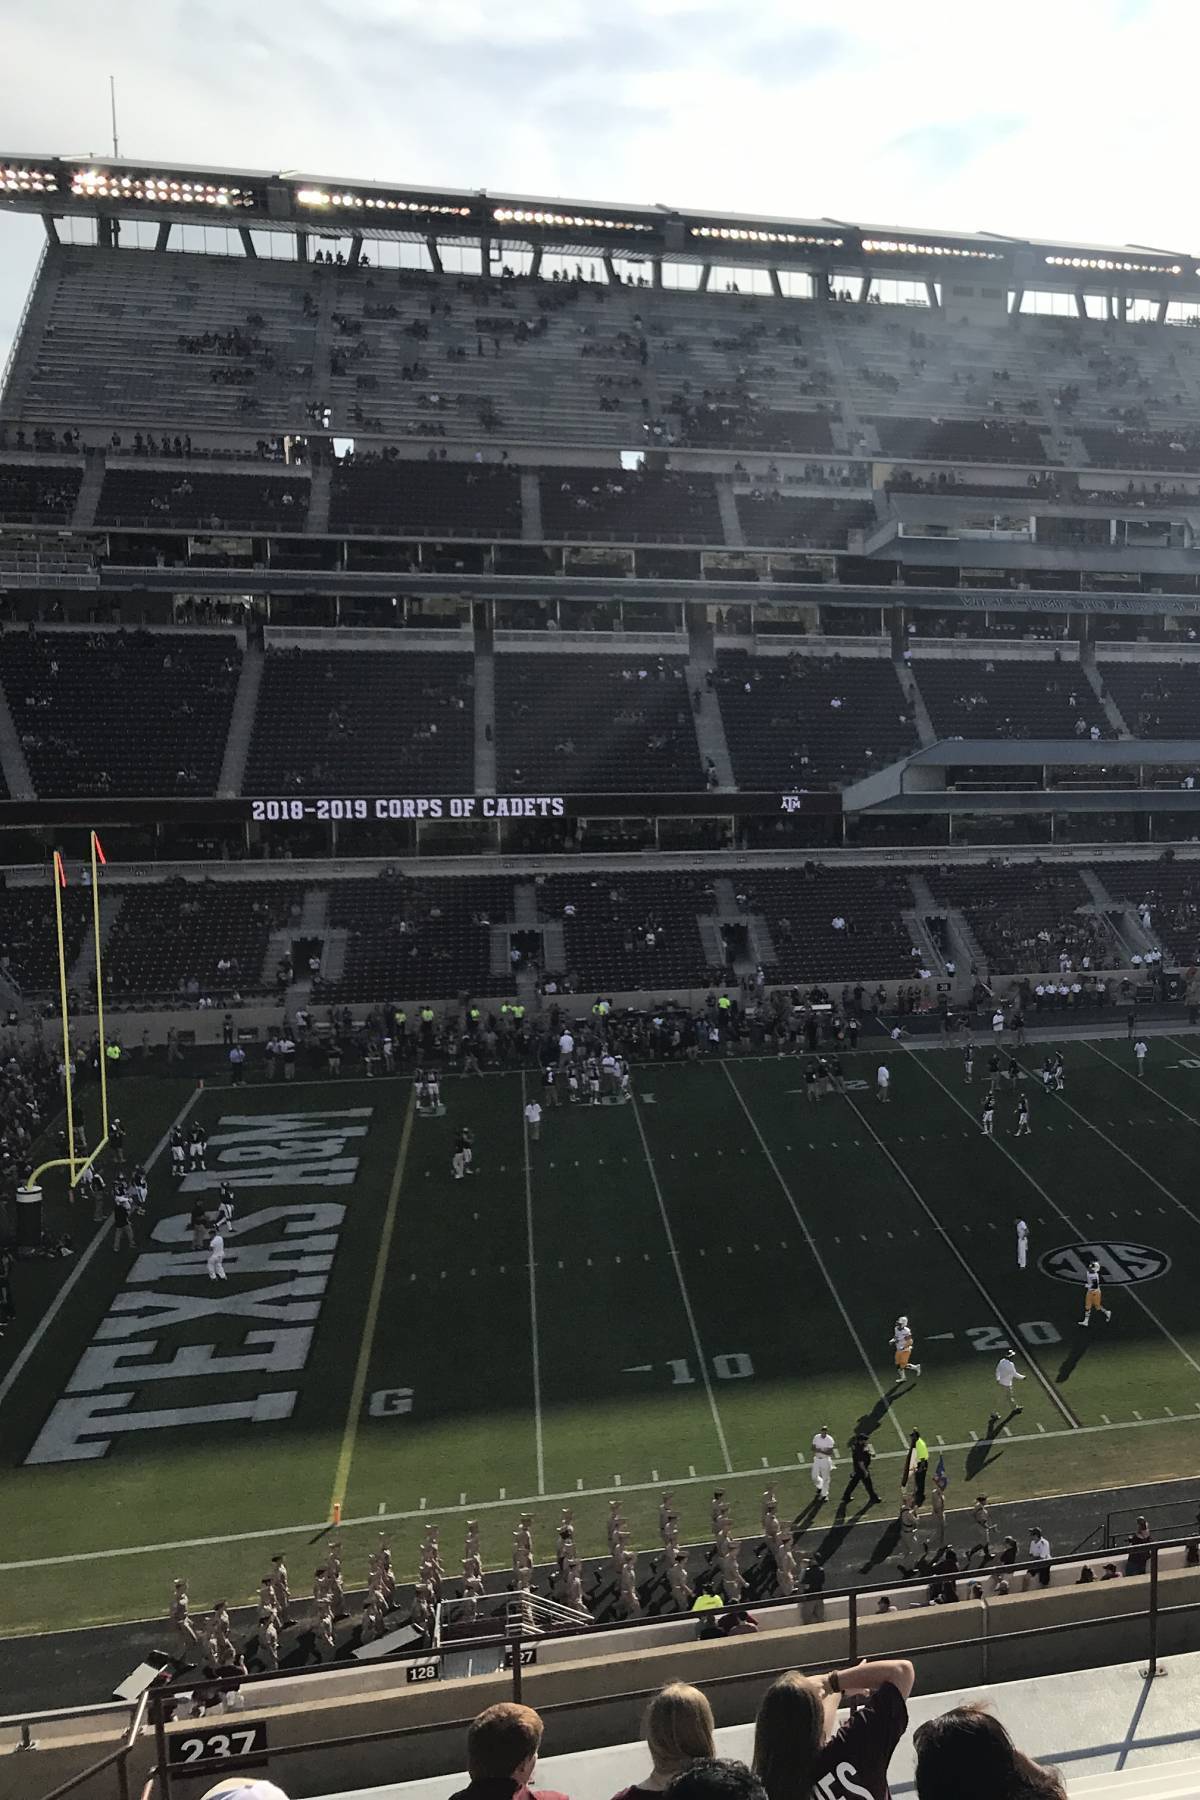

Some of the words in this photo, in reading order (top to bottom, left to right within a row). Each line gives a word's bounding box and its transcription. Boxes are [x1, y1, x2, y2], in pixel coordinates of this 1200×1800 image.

[252, 800, 367, 820] 2018-2019
[376, 799, 443, 819] CORPS
[450, 799, 476, 818] OF
[483, 797, 564, 817] CADETS
[177, 1107, 375, 1192] A&M
[23, 1202, 348, 1465] TEXAS
[964, 1320, 1064, 1352] 20
[664, 1352, 754, 1385] 10
[368, 1386, 414, 1417] G
[409, 1665, 436, 1682] 128
[179, 1729, 257, 1764] 237
